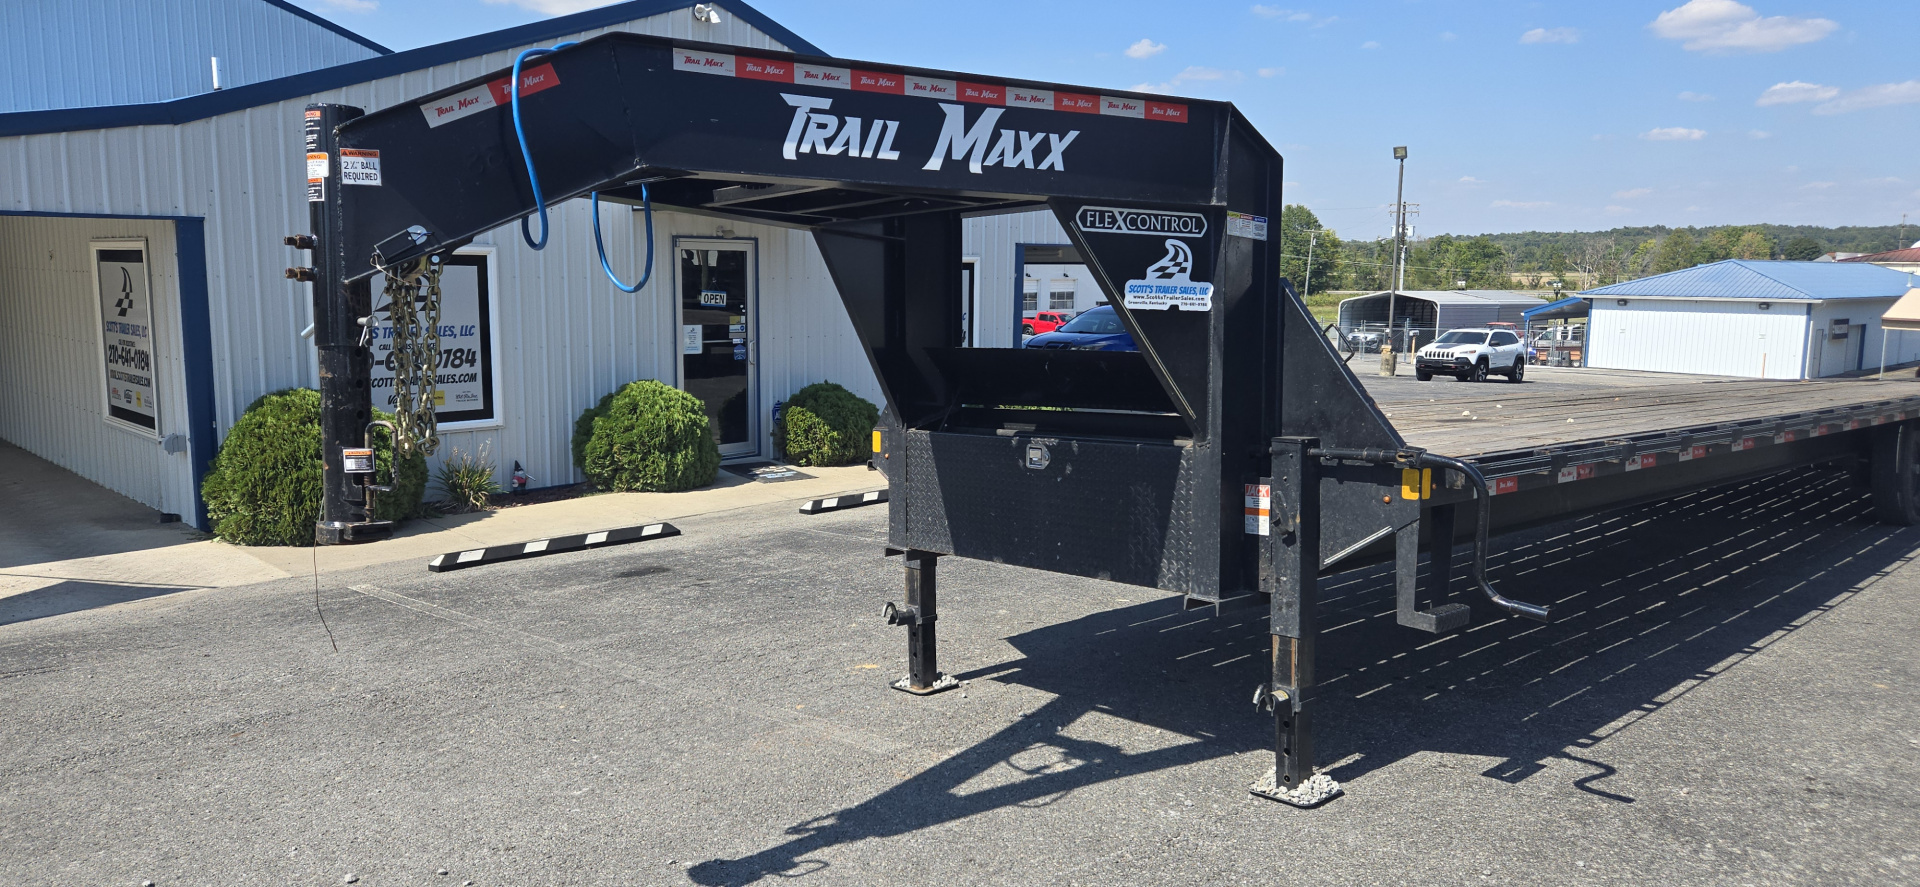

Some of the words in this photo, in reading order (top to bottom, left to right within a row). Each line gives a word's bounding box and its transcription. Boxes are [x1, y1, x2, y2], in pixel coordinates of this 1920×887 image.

[779, 92, 901, 160] TRAIL
[921, 102, 1081, 174] MAXX
[361, 161, 378, 171] BALL
[343, 171, 379, 182] REQUIRED
[1086, 209, 1200, 233] FLEXCONTROL
[1128, 284, 1154, 294] SCOTT'S
[1155, 285, 1178, 295] TRAILER
[1179, 286, 1198, 296] SALES,
[1199, 287, 1209, 296] LLC
[703, 293, 725, 305] OPEN
[460, 325, 475, 337] LLC
[1246, 485, 1270, 498] JACK
